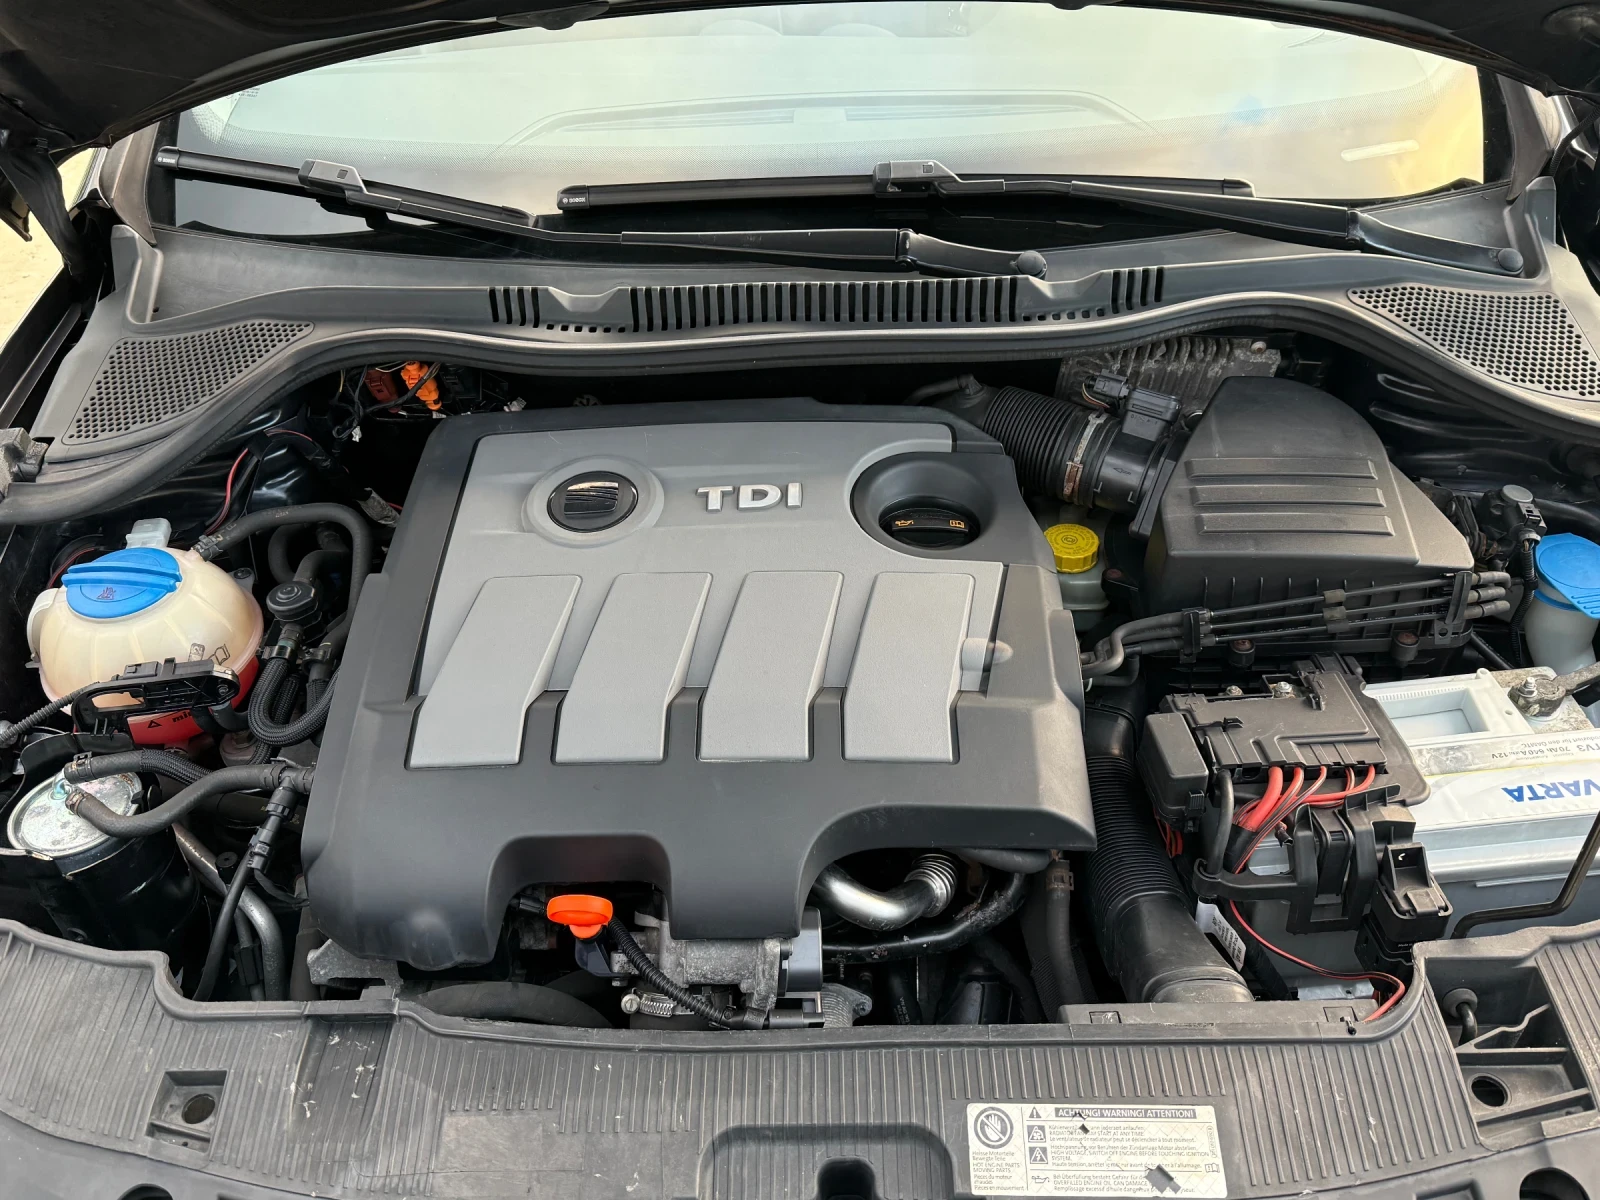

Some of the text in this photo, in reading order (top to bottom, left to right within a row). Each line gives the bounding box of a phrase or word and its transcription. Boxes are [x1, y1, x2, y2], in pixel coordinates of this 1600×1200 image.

[696, 482, 804, 512] TDI
[1501, 779, 1600, 802] VARTA
[1058, 1109, 1194, 1118] ACHTUNG! WARNING! ATTENTION!
